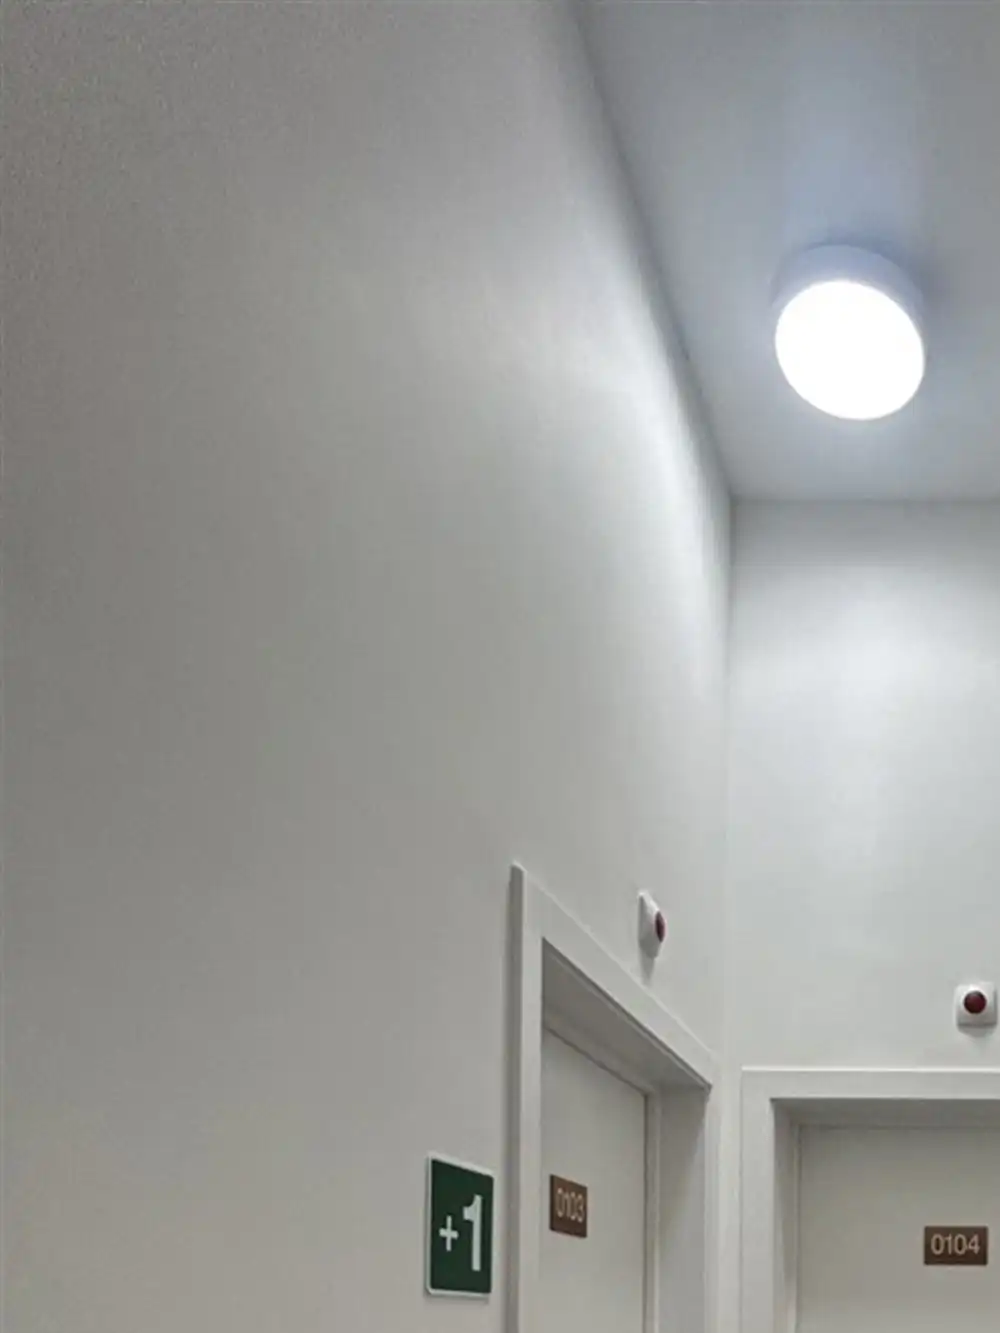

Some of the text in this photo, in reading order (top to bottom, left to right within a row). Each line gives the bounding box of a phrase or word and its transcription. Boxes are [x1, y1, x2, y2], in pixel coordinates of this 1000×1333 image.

[555, 1187, 584, 1223] 0103
[439, 1194, 483, 1271] +1
[930, 1233, 980, 1255] 0104
